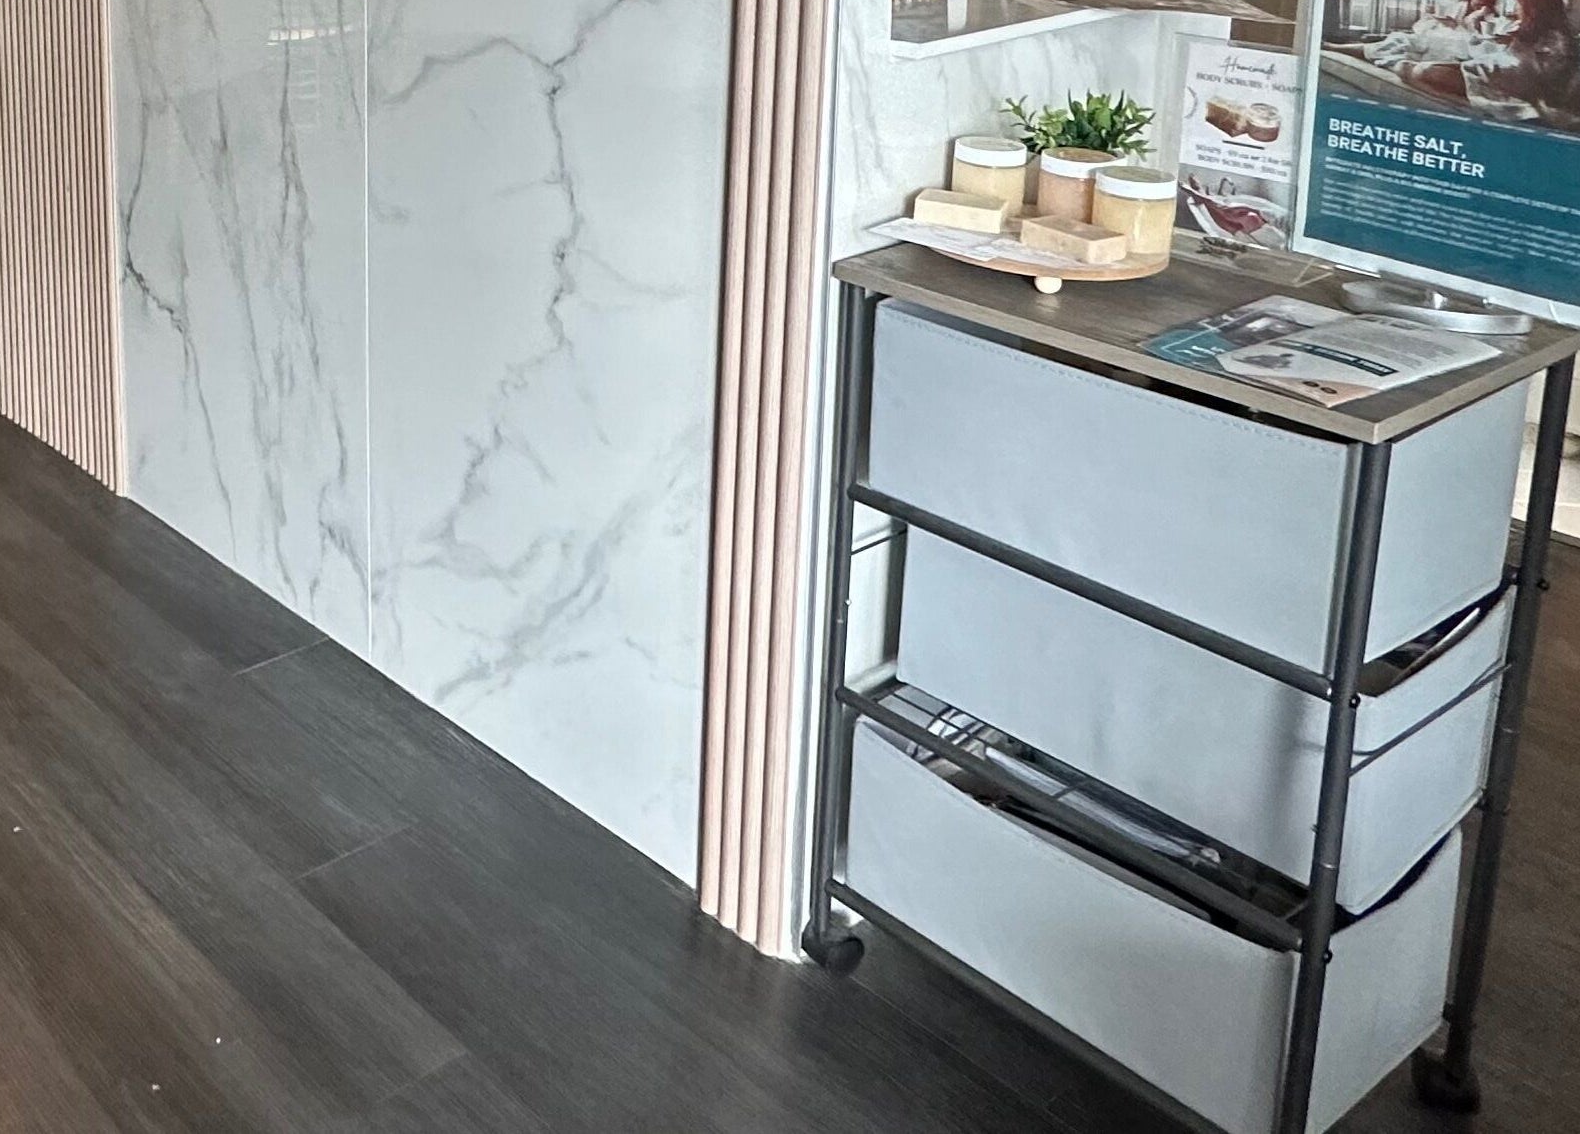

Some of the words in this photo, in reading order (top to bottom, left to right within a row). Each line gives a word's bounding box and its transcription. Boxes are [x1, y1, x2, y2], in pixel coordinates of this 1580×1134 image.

[1196, 72, 1223, 84] BODY
[1327, 134, 1408, 164] BREATHE
[1411, 152, 1486, 179] BETTER
[1328, 117, 1411, 147] BREATHE
[1414, 134, 1467, 160] SALT,
